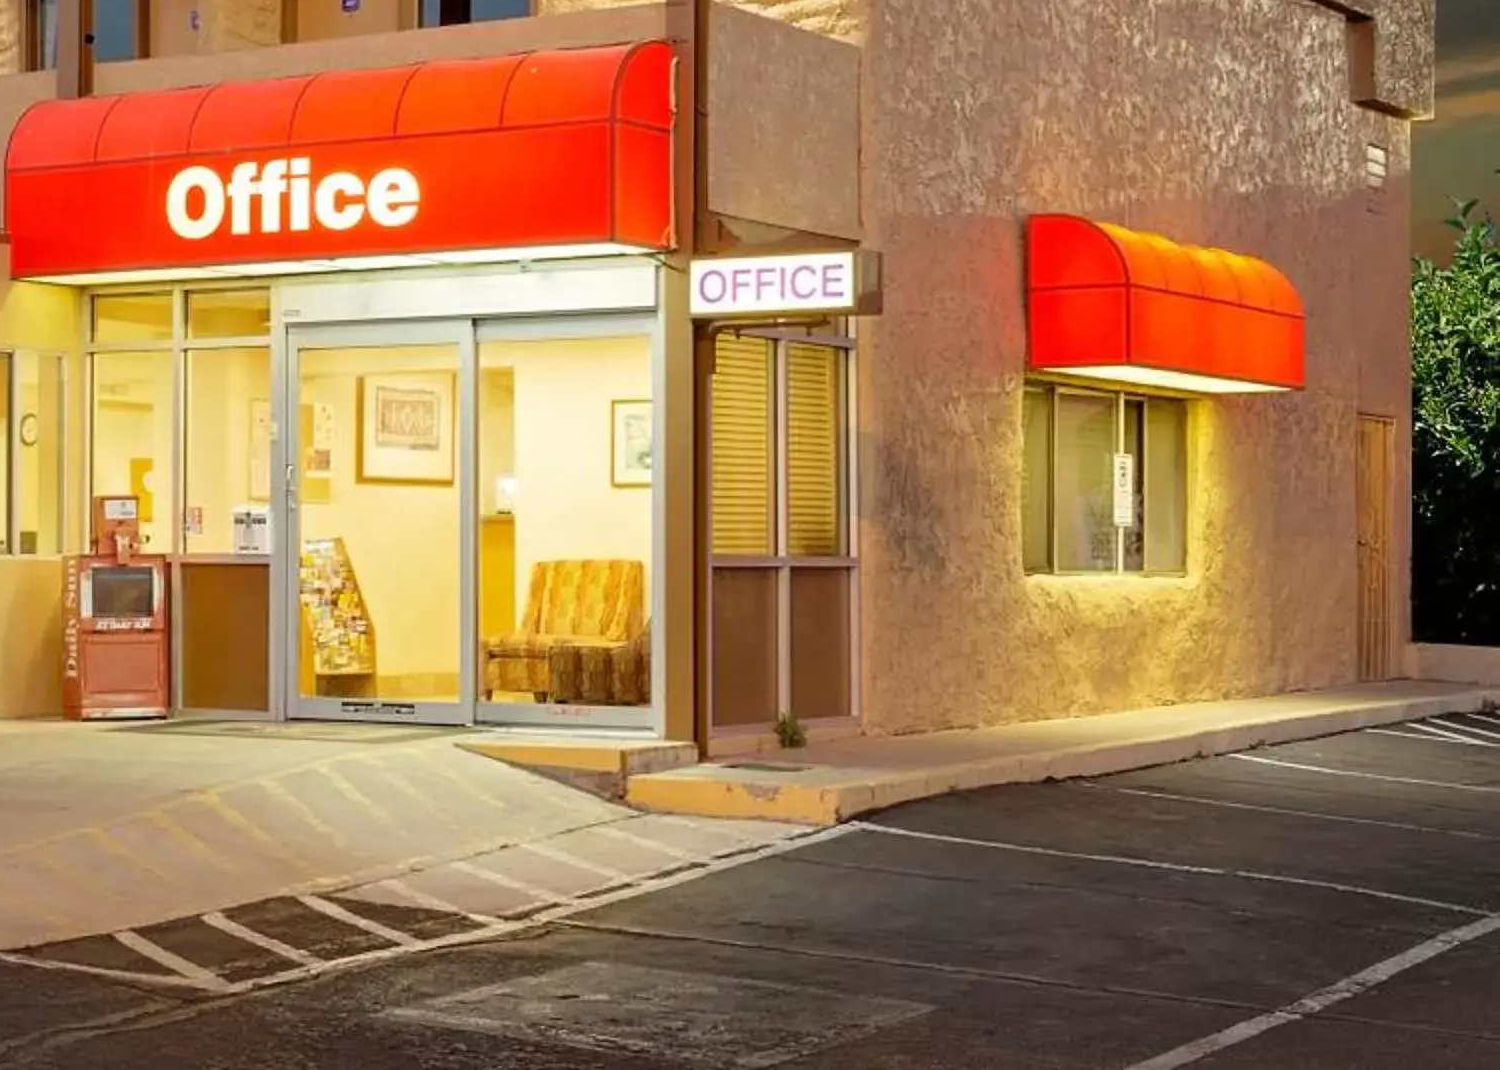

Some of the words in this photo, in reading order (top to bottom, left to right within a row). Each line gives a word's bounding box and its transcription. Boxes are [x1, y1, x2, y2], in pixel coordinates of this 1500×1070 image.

[166, 157, 420, 239] Office
[700, 264, 845, 304] OFFICE
[64, 559, 77, 609] Sun
[64, 619, 80, 678] Daily
